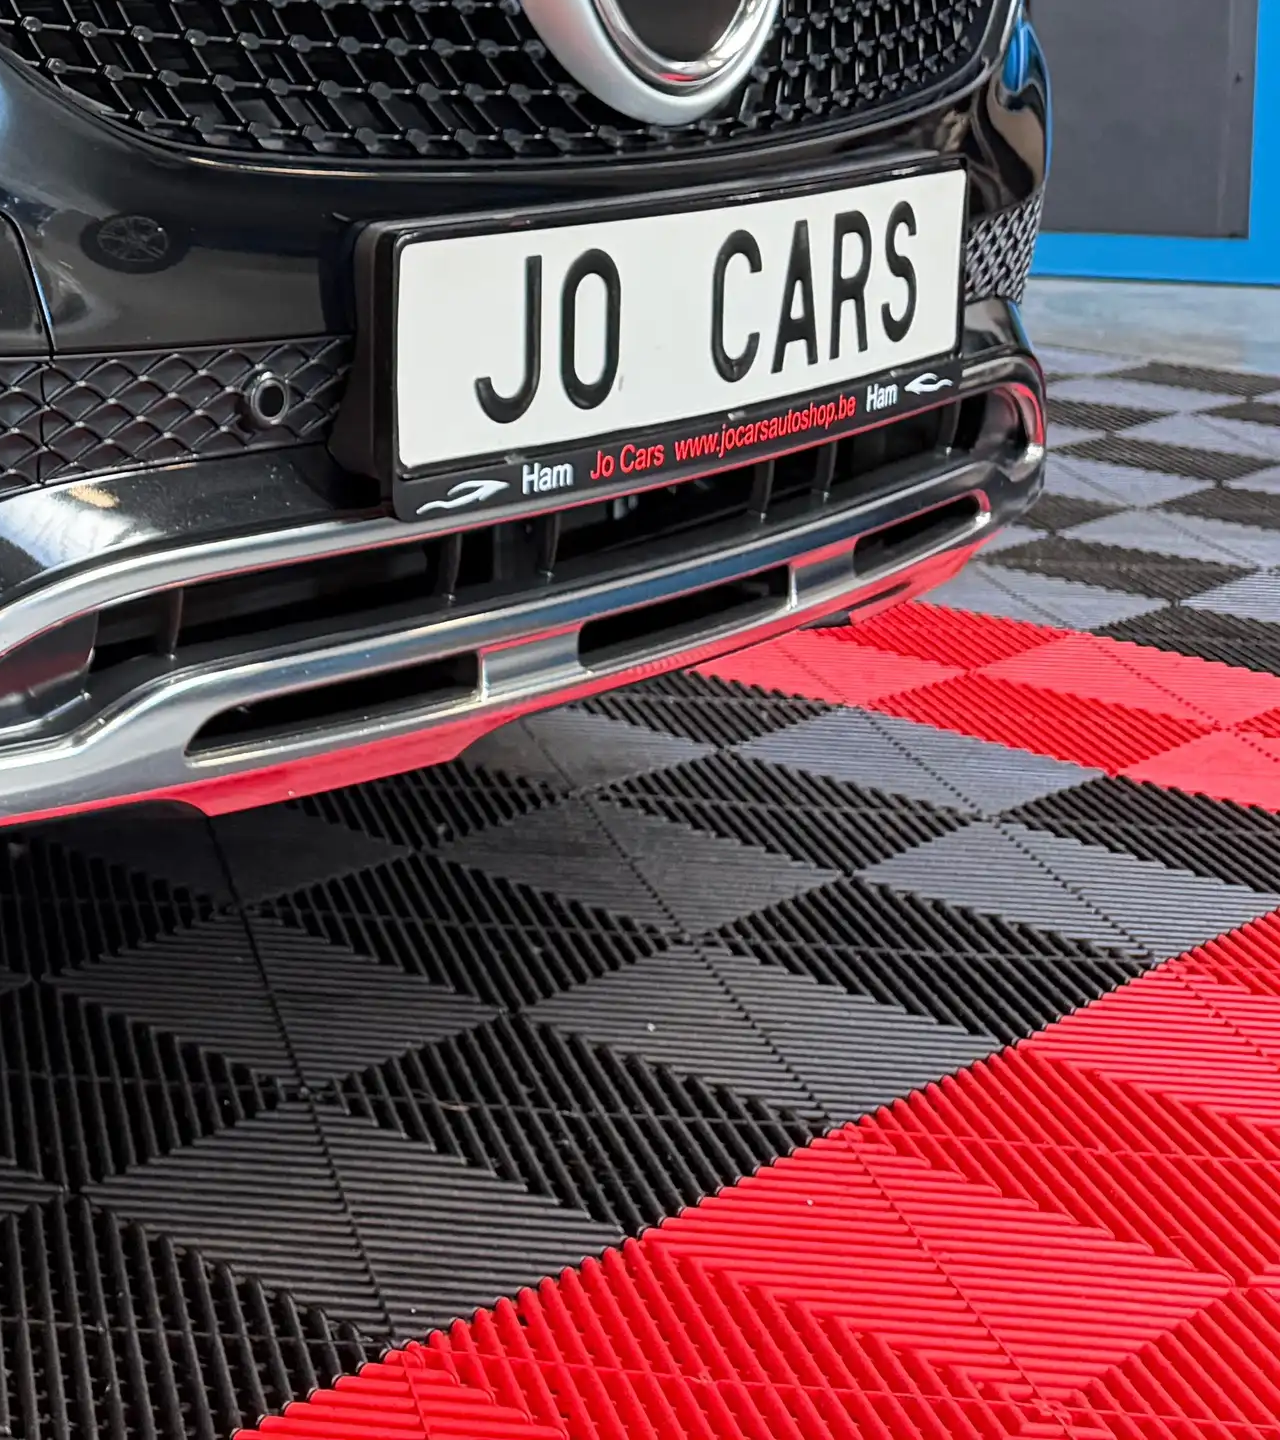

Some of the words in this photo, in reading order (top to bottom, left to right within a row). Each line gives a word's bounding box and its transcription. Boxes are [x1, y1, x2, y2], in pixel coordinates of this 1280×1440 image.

[473, 247, 622, 424] JO
[710, 200, 918, 383] CARS
[521, 461, 575, 496] Ham
[589, 449, 615, 481] Jo
[618, 443, 666, 475] Cars
[673, 392, 857, 463] www.jocarsautoshop.be
[864, 382, 899, 413] Ham
